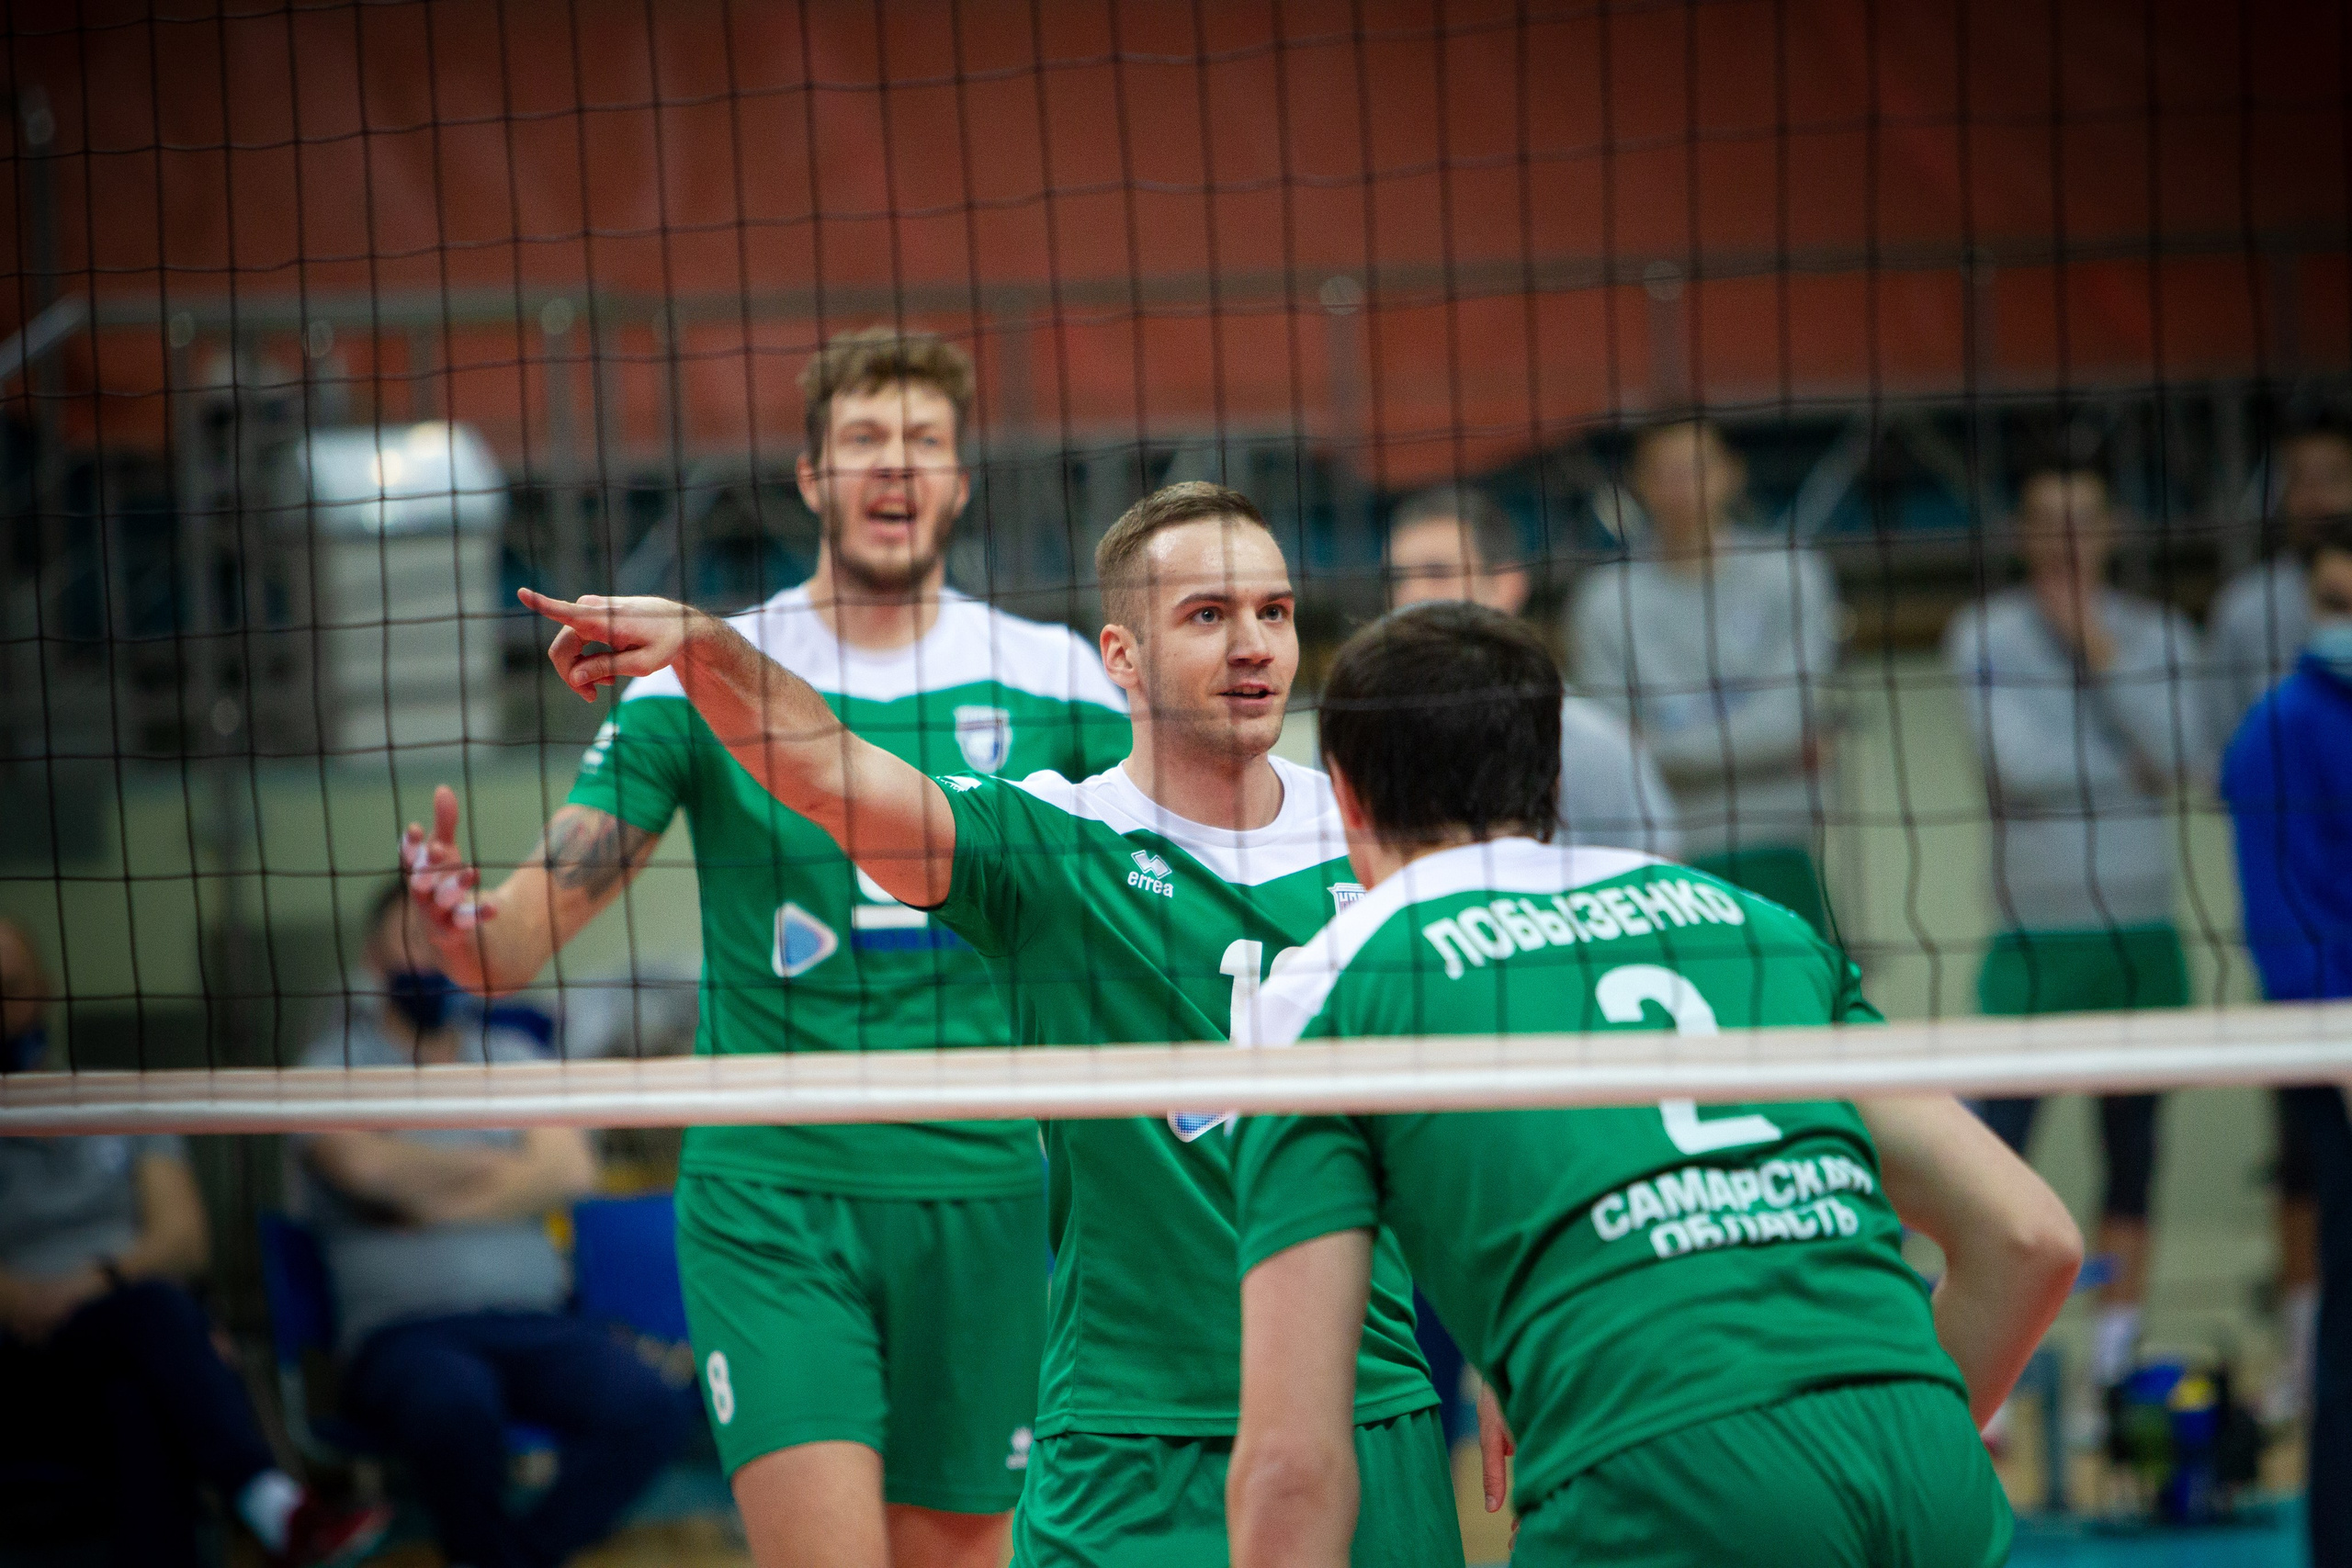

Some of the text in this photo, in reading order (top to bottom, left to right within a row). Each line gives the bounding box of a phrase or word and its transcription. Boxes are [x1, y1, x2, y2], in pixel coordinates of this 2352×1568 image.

[1127, 871, 1174, 898] errea
[1422, 878, 1745, 979] ЛОБЫЗЕНКО
[1594, 963, 1783, 1156] 2
[706, 1349, 735, 1425] 8
